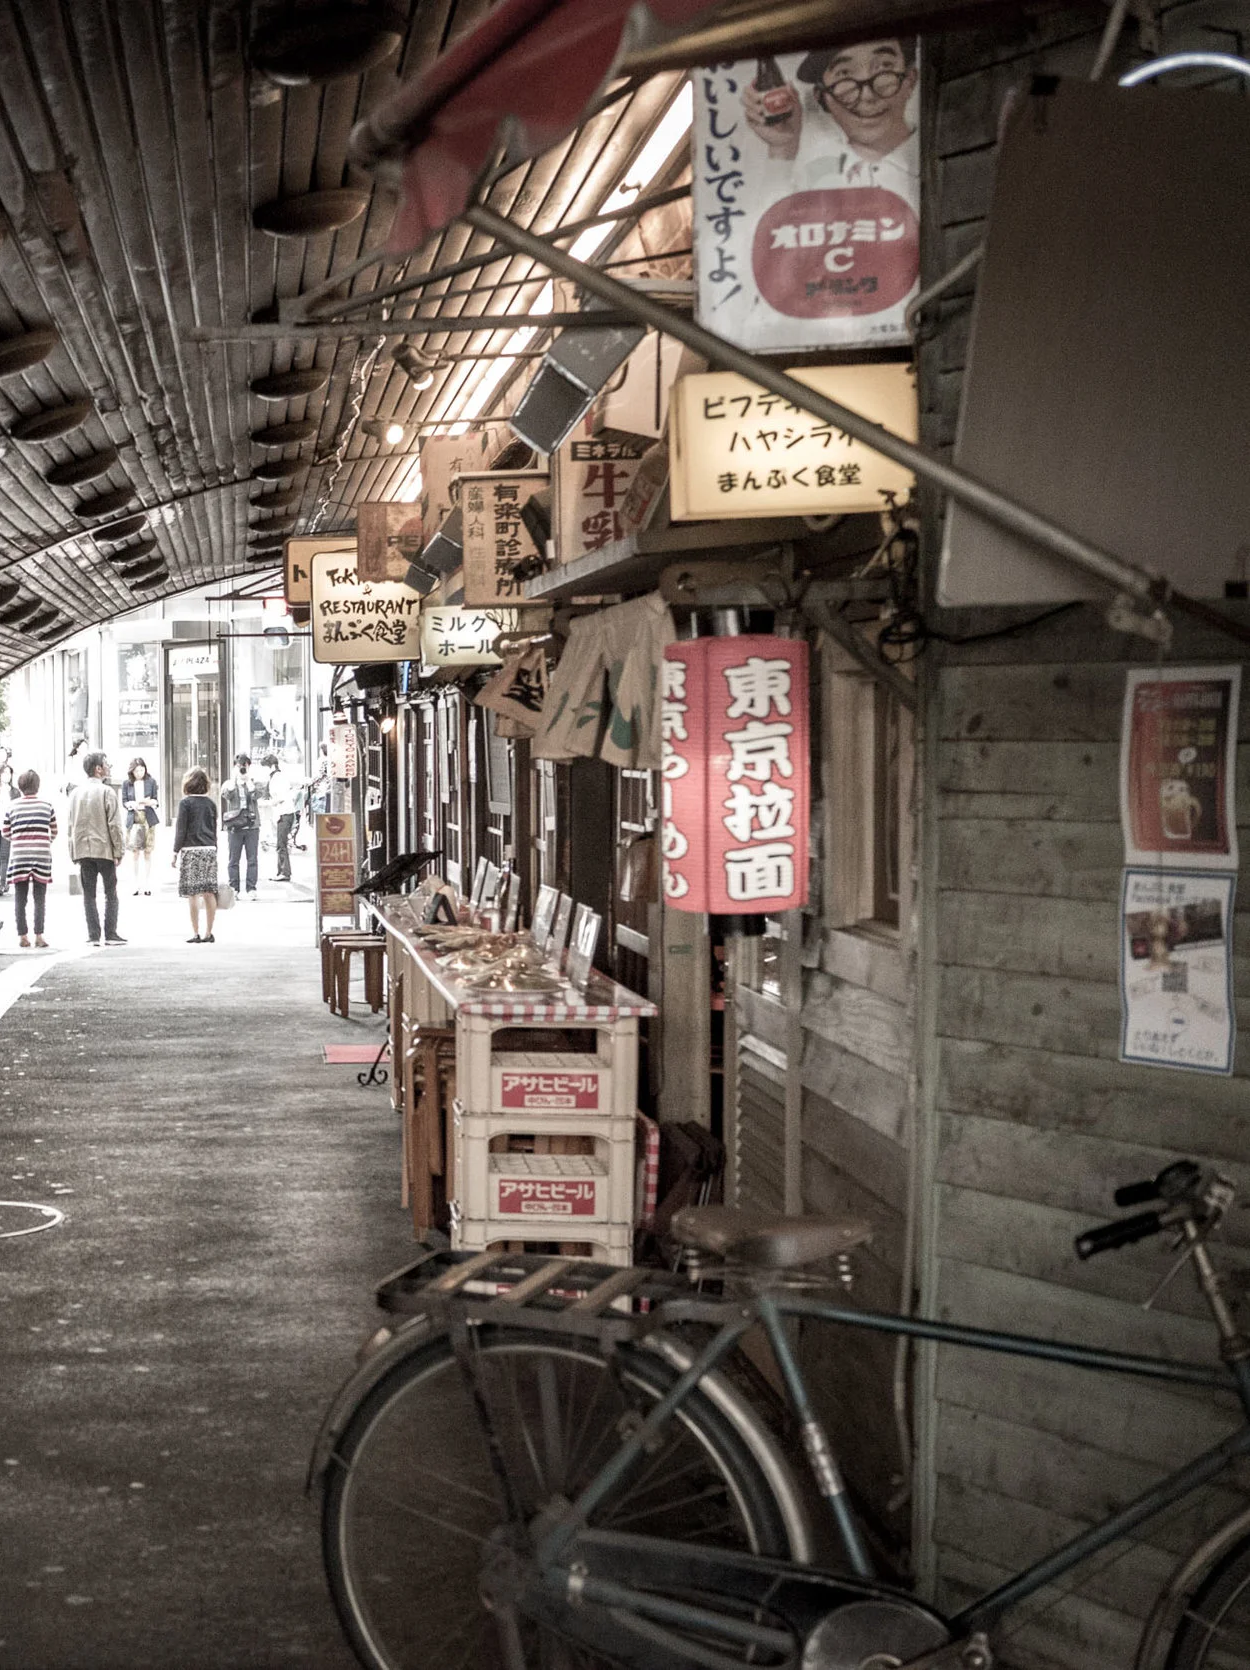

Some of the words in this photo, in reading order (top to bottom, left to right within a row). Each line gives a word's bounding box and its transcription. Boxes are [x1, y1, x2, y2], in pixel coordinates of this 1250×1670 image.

[770, 217, 905, 249] オロナミン
[823, 248, 855, 272] C
[493, 483, 522, 597] 有楽町診療所
[320, 597, 417, 619] RESTAURANT
[431, 615, 487, 633] ミルク
[438, 639, 493, 657] ホール
[722, 656, 796, 902] 東京拉面
[322, 842, 351, 862] 24H
[502, 1075, 597, 1094] アサヒビール
[500, 1182, 594, 1200] アサヒビール
